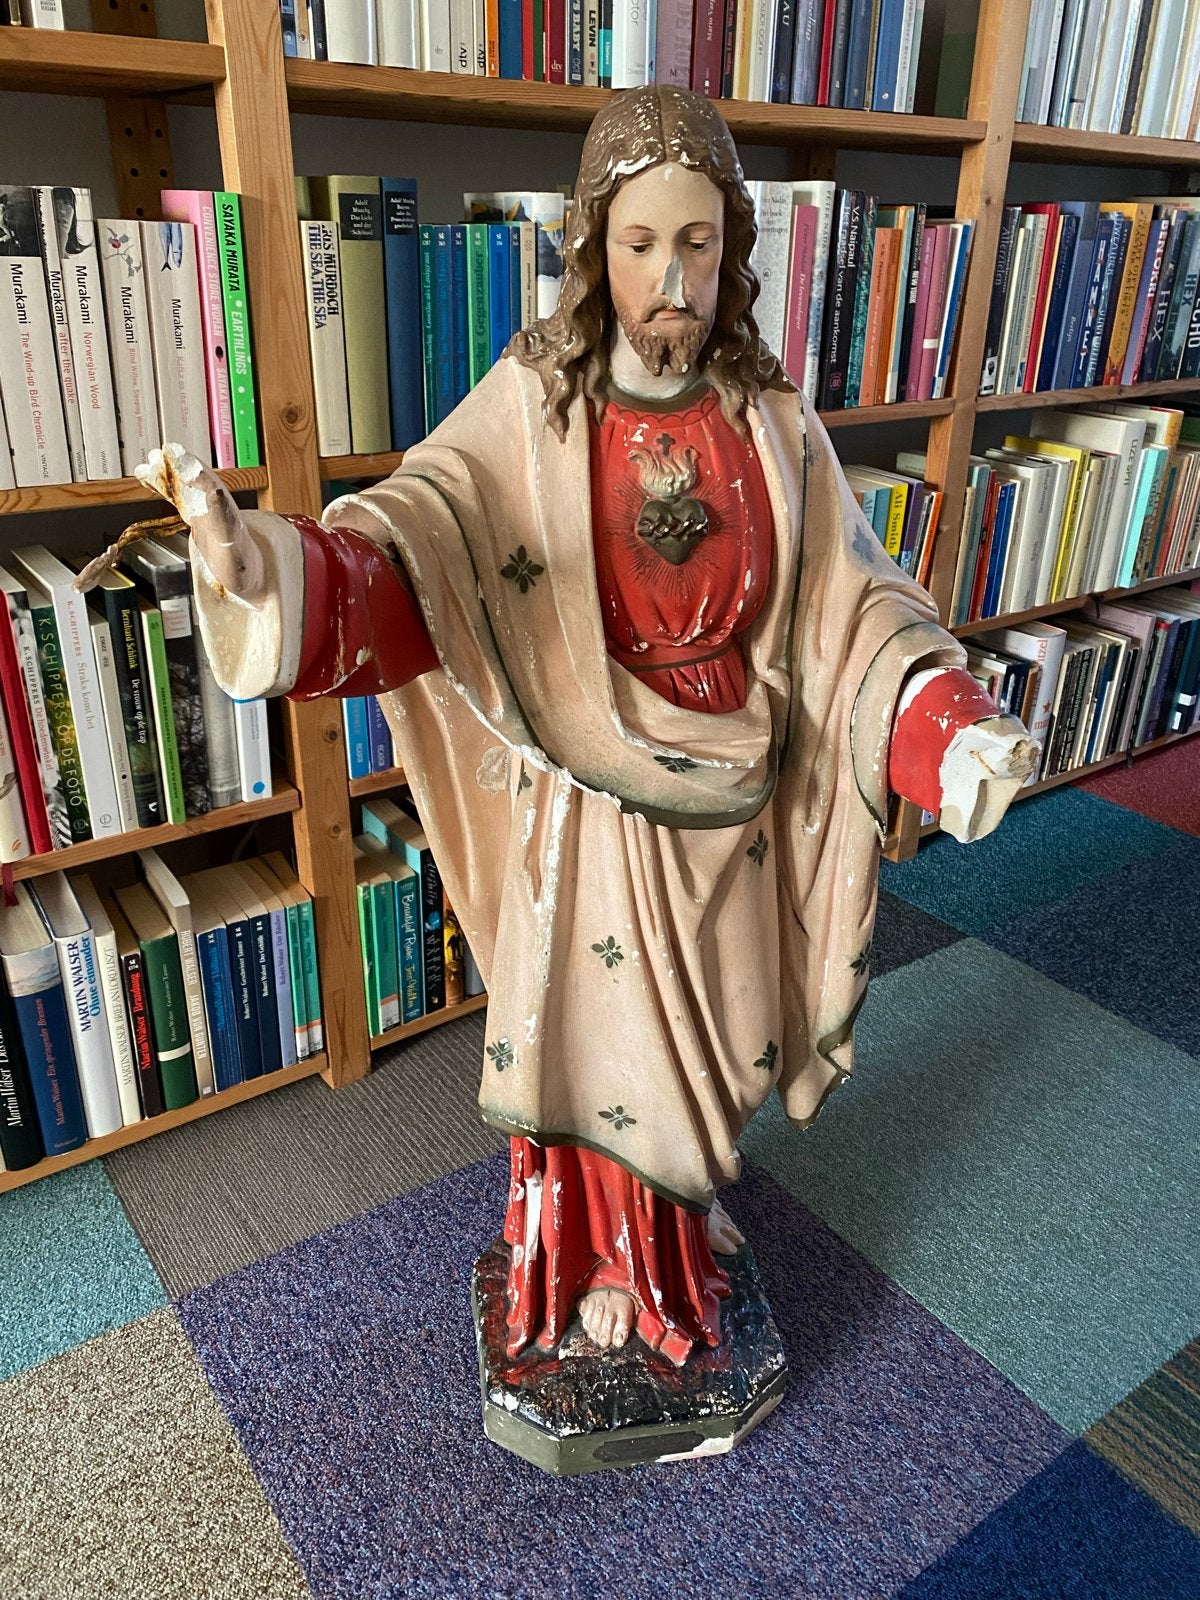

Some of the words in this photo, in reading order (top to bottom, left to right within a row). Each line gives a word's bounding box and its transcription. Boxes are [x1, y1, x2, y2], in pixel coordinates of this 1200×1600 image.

[572, 17, 581, 52] BABY
[588, 10, 596, 47] LEVIN
[458, 47, 467, 68] dtv
[477, 49, 485, 68] dtv
[551, 59, 562, 70] dtv
[202, 206, 217, 270] CONVENIENCE
[222, 203, 236, 246] SAYAKA
[308, 224, 322, 250] THE
[1156, 219, 1169, 252] BEN
[847, 225, 858, 268] Naipaul
[995, 226, 1011, 285] Allerzielen
[226, 249, 240, 292] MURATA
[311, 252, 323, 280] SEA,
[911, 270, 919, 285] NEW
[1147, 256, 1162, 298] OKRI
[10, 263, 31, 324] Murakami
[75, 265, 94, 324] Murakami
[208, 273, 219, 301] STORE
[312, 278, 325, 304] THE
[323, 253, 339, 316] MURDOCH
[474, 250, 487, 336] Gegenzauber
[836, 270, 844, 292] van
[908, 286, 917, 303] YORK
[1182, 273, 1198, 306] HEX
[49, 270, 69, 325] Murakami
[835, 293, 843, 308] de
[1079, 239, 1106, 372] HAMNET
[120, 286, 138, 344] Murakami
[171, 299, 186, 349] Murakami
[211, 303, 223, 337] WOMAN
[314, 306, 327, 330] SEA
[1152, 288, 1171, 341] HEX
[21, 332, 29, 348] The
[59, 332, 69, 355] after
[231, 310, 247, 375] EARTHLINGS
[830, 308, 840, 363] aankomst
[24, 351, 35, 387] Wind-up
[62, 358, 73, 373] the
[83, 332, 96, 382] Norwegian
[29, 389, 39, 407] Bird
[64, 376, 76, 404] quake
[89, 384, 101, 409] Wood
[32, 410, 45, 450] Chronicle
[1127, 439, 1139, 464] LIZE
[1123, 464, 1132, 486] SPIT
[894, 490, 903, 509] Ali
[889, 512, 900, 549] Smith
[38, 618, 51, 631] K.
[69, 610, 82, 657] SCHIPPERS
[121, 609, 133, 642] Bernhard
[126, 642, 138, 669] Schlink
[41, 632, 67, 719] SCHIPPERS
[77, 662, 87, 691] Straks
[131, 678, 140, 689] De
[25, 656, 40, 704] SCHIPPERS
[38, 719, 54, 771] hoedenwinkel
[82, 691, 92, 714] komt
[133, 689, 142, 710] vrouw
[86, 714, 95, 730] het
[134, 711, 143, 721] op
[138, 721, 146, 731] de
[57, 724, 71, 745] OP
[138, 731, 147, 744] trap
[61, 747, 75, 767] DE
[65, 769, 82, 807] FOTO
[401, 891, 416, 933] Beautiful
[180, 929, 193, 957] ROBERT
[404, 932, 417, 961] Ruins
[67, 940, 83, 987] WALSER
[81, 936, 97, 984] einander
[184, 958, 197, 986] WALSER
[426, 935, 437, 990] WATERS
[89, 984, 101, 1017] Ohne
[131, 972, 144, 1013] Brandung
[189, 994, 201, 1016] JAKOB
[241, 987, 249, 1004] Walser
[406, 979, 418, 1008] Walter
[75, 988, 92, 1033] MARTIN
[117, 1026, 129, 1057] WALSER
[136, 1016, 148, 1042] Walser
[140, 1042, 151, 1070] Martin
[121, 1057, 132, 1087] MARTIN
[3, 1095, 22, 1126] Martin
